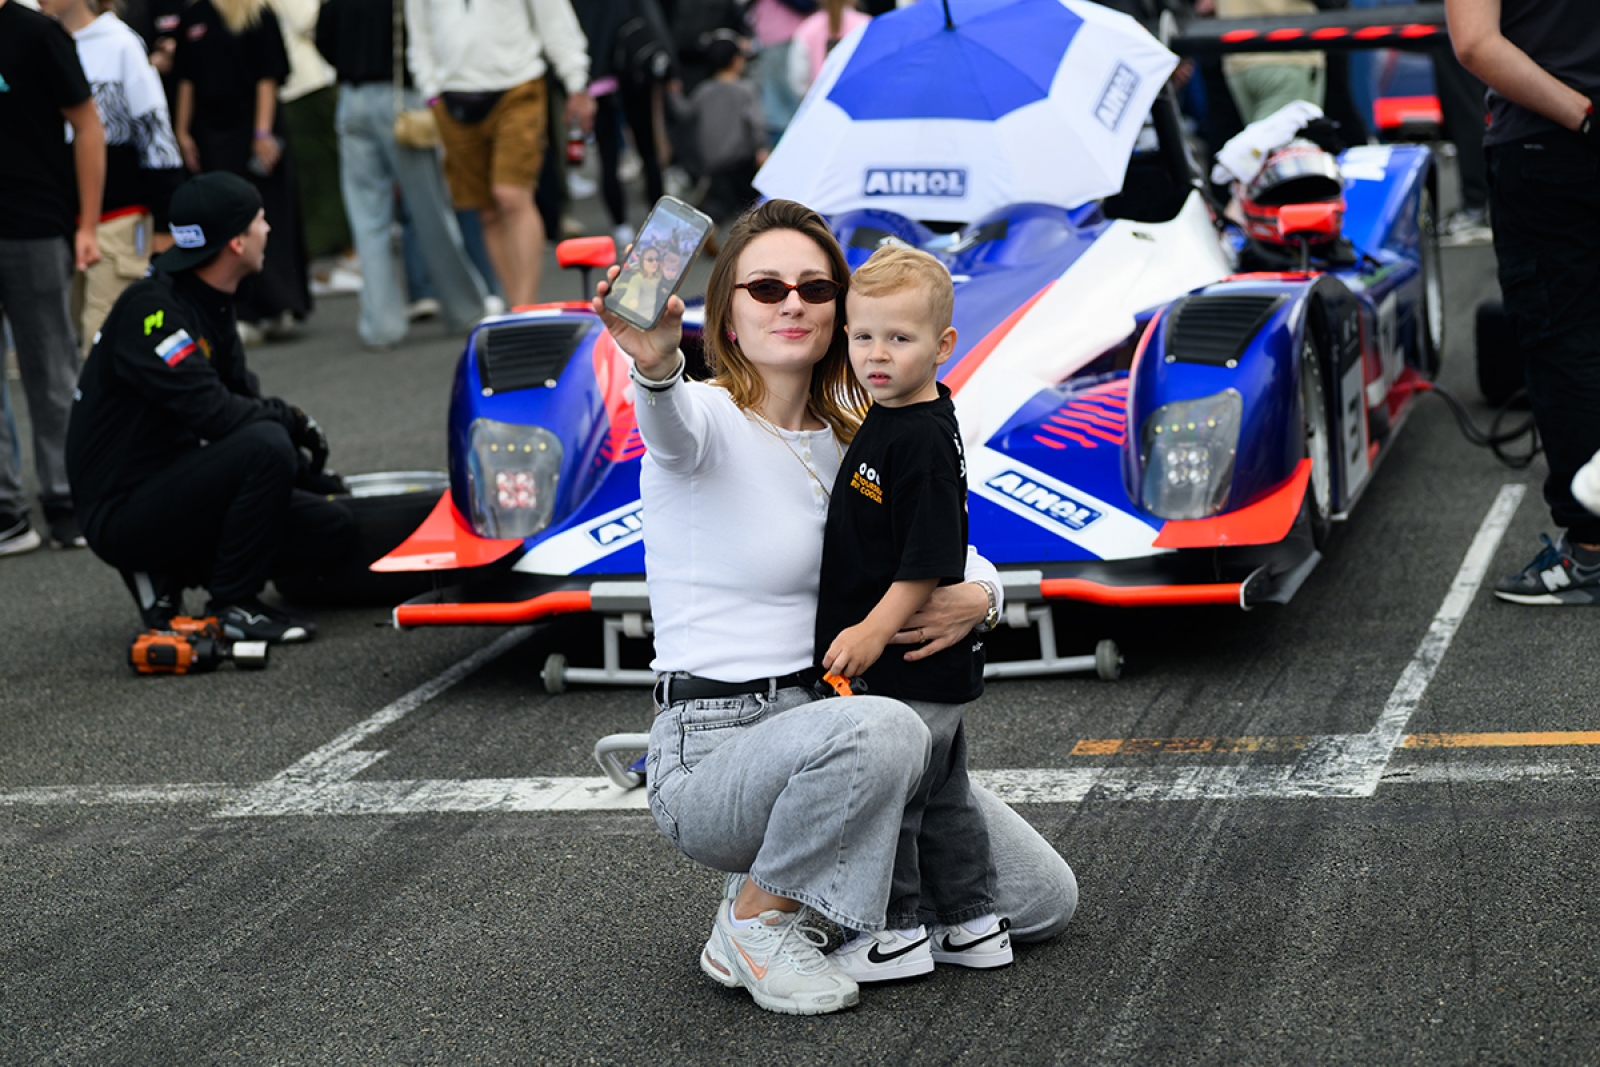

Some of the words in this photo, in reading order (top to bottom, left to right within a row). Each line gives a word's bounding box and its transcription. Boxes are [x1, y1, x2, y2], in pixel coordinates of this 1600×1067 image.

[1098, 66, 1136, 129] AIMOL
[866, 171, 964, 194] AIMOL
[988, 472, 1092, 526] AIMOL
